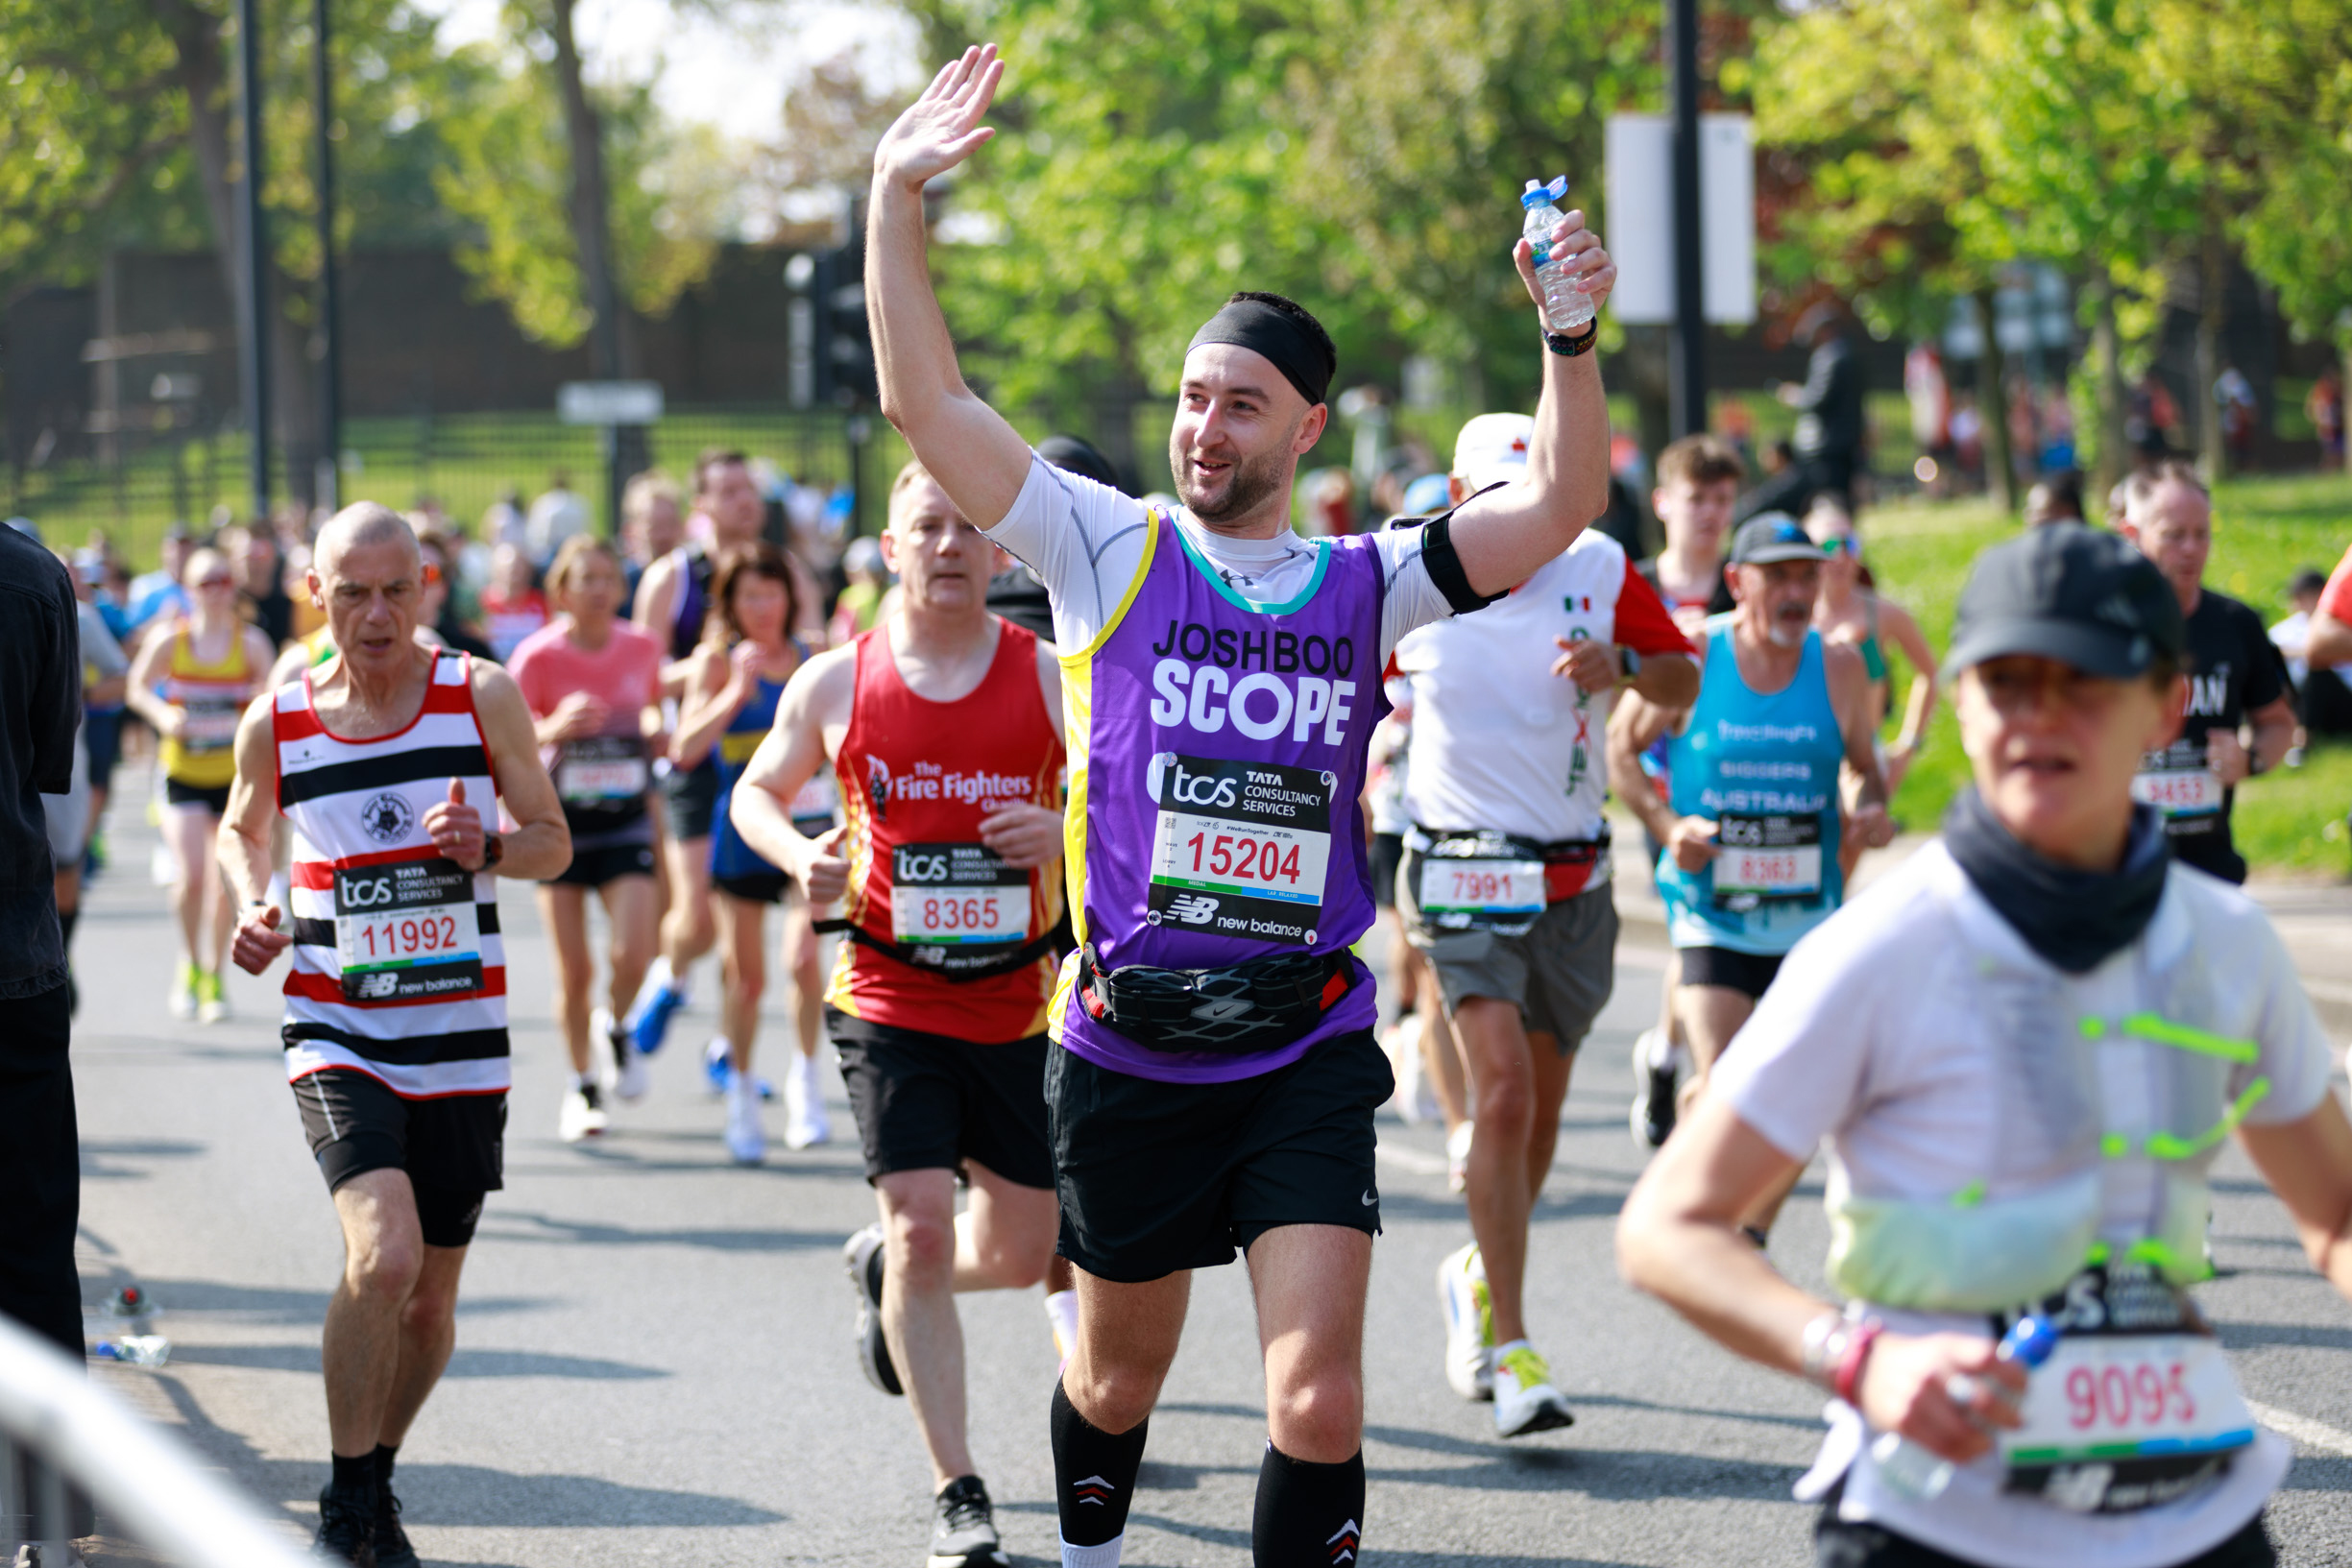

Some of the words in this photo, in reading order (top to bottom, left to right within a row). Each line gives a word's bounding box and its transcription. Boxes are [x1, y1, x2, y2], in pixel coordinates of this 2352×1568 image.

[1151, 658, 1356, 746] SCOPE
[914, 760, 942, 777] The
[1246, 770, 1284, 786] TATA
[895, 774, 939, 800] Fire
[943, 770, 1032, 805] Fighters
[1173, 764, 1238, 808] tcs
[1244, 785, 1321, 807] CONSULTANCY
[1242, 800, 1297, 817] SERVICES
[950, 848, 983, 859] TATA
[1187, 832, 1300, 884] 15204
[394, 866, 427, 879] TATA
[898, 850, 948, 881] tcs
[341, 876, 393, 908] tcs
[396, 874, 465, 890] CONSULTANCY
[1188, 880, 1206, 888] MEDAL
[1452, 872, 1513, 900] 7991
[397, 888, 444, 902] SERVICES
[923, 898, 1000, 929] 8365
[361, 916, 457, 956] 11992
[1217, 916, 1248, 930] new
[1249, 918, 1302, 937] balance
[399, 981, 424, 995] new
[425, 977, 473, 992] balance
[2065, 1363, 2197, 1430] 9095
